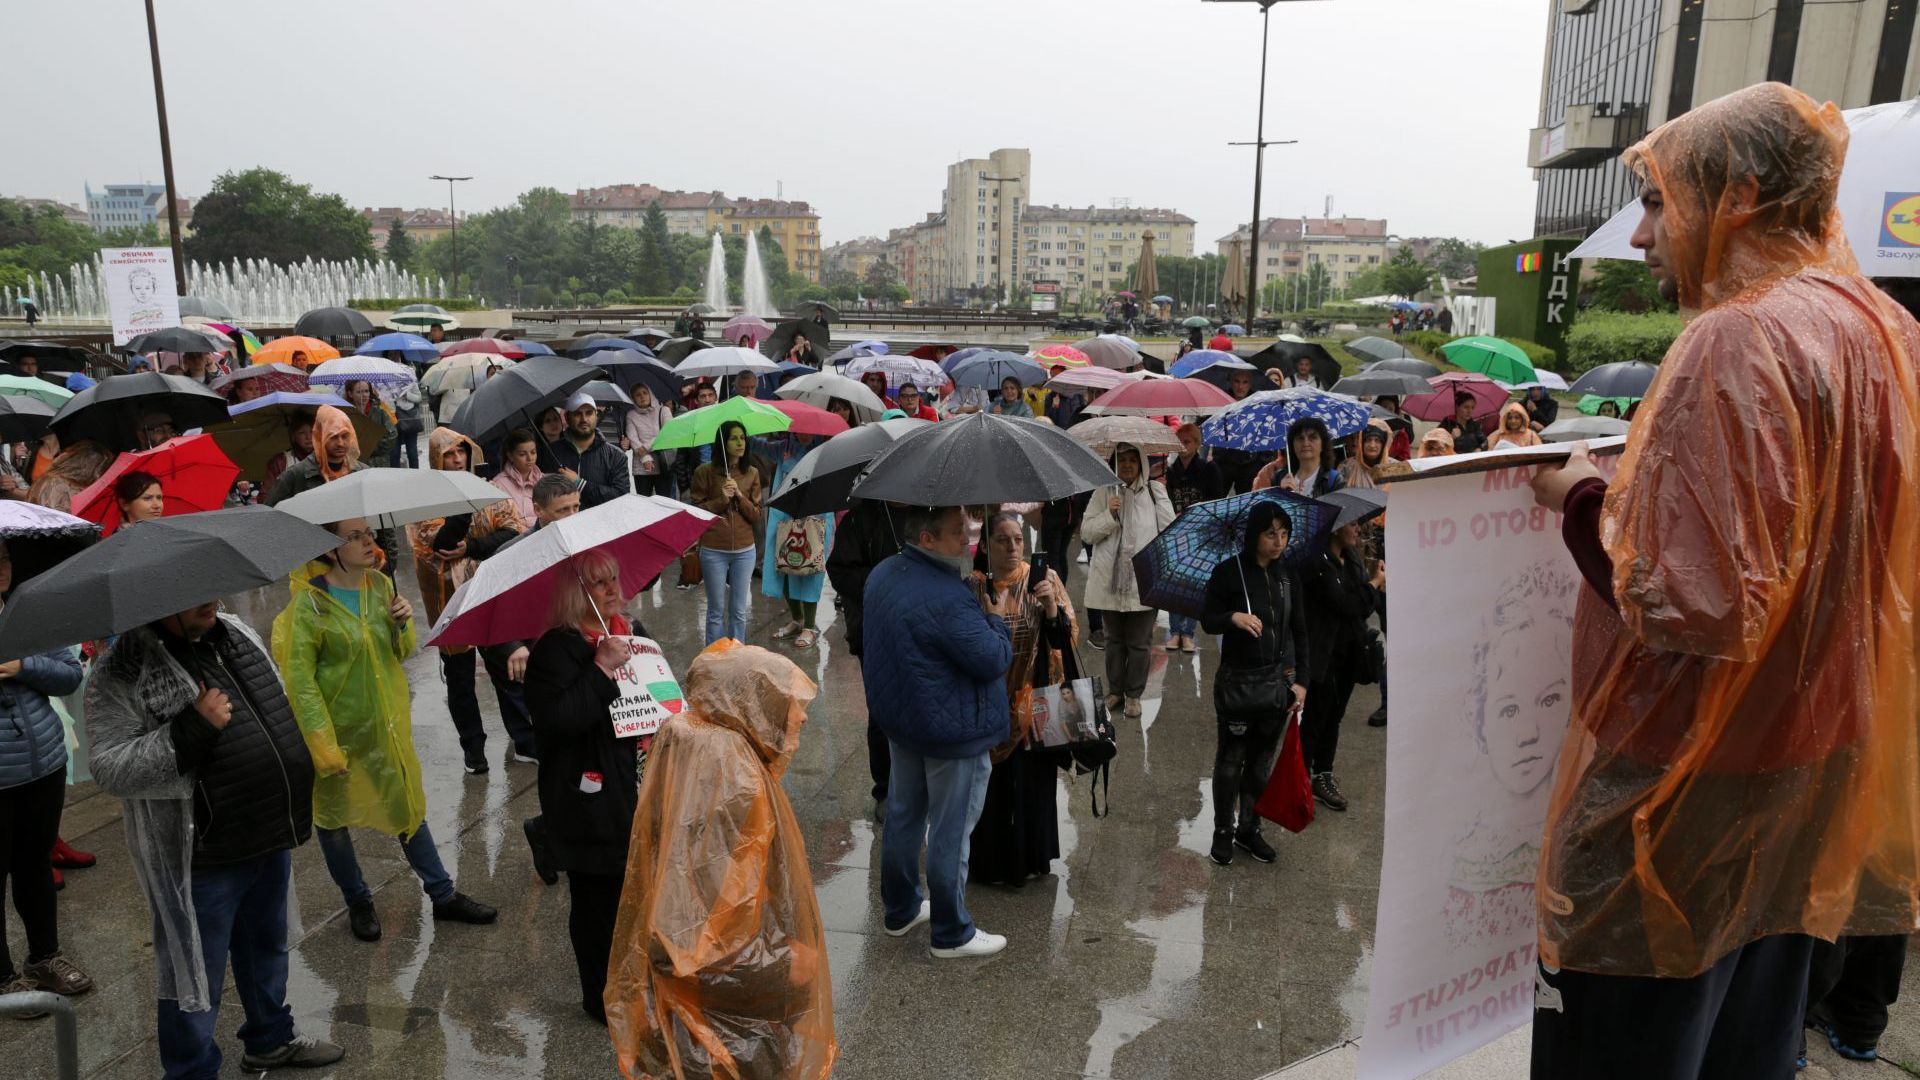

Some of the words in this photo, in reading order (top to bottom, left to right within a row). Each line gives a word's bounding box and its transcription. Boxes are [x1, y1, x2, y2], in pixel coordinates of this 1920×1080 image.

[1547, 252, 1570, 323] НДК
[612, 694, 652, 709] ОТМЯНА
[611, 706, 658, 722] СТРАТЕГИЯ
